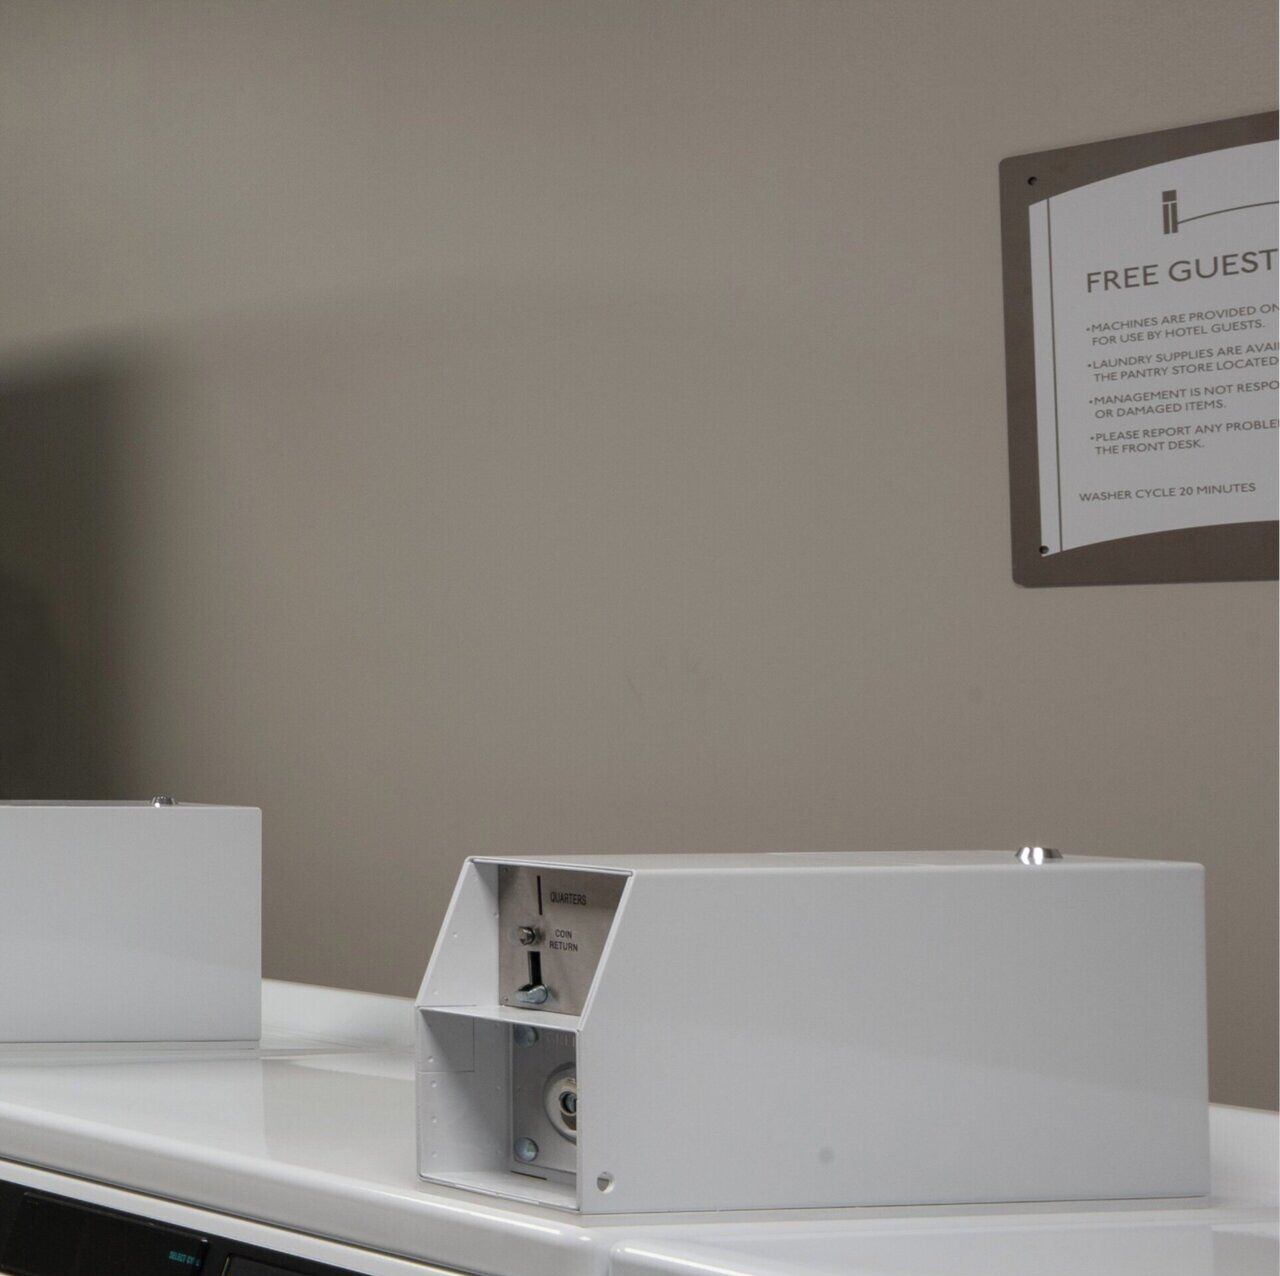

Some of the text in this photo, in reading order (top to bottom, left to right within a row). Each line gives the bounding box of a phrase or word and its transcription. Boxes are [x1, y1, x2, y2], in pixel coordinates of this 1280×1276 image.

[1086, 248, 1279, 293] FREE GUEST
[1092, 316, 1158, 332] MACHINES
[1161, 313, 1186, 326] ARE
[1190, 306, 1256, 321] PROVIDED
[1092, 319, 1266, 346] FOR USE BY HOTEL GUESTS.
[1093, 342, 1279, 370] LAUNDRY SUPPLIES ARE AVAI
[1094, 356, 1279, 382] THE PANTRY STORE LOCATED
[1094, 388, 1187, 405] MANAGEMENT
[1190, 387, 1201, 397] IS
[1204, 384, 1234, 396] NOT
[1095, 399, 1227, 419] OR DAMAGED ITEMS.
[1096, 419, 1279, 442] PLEASE REPORT ANY PROBLE
[1095, 439, 1205, 455] THE FRONT DESK.
[1080, 482, 1257, 502] WASHER CYCLE 20 MINUTES
[550, 891, 587, 906] QUARTERS
[554, 928, 572, 939] COIN
[549, 940, 578, 952] RETURN
